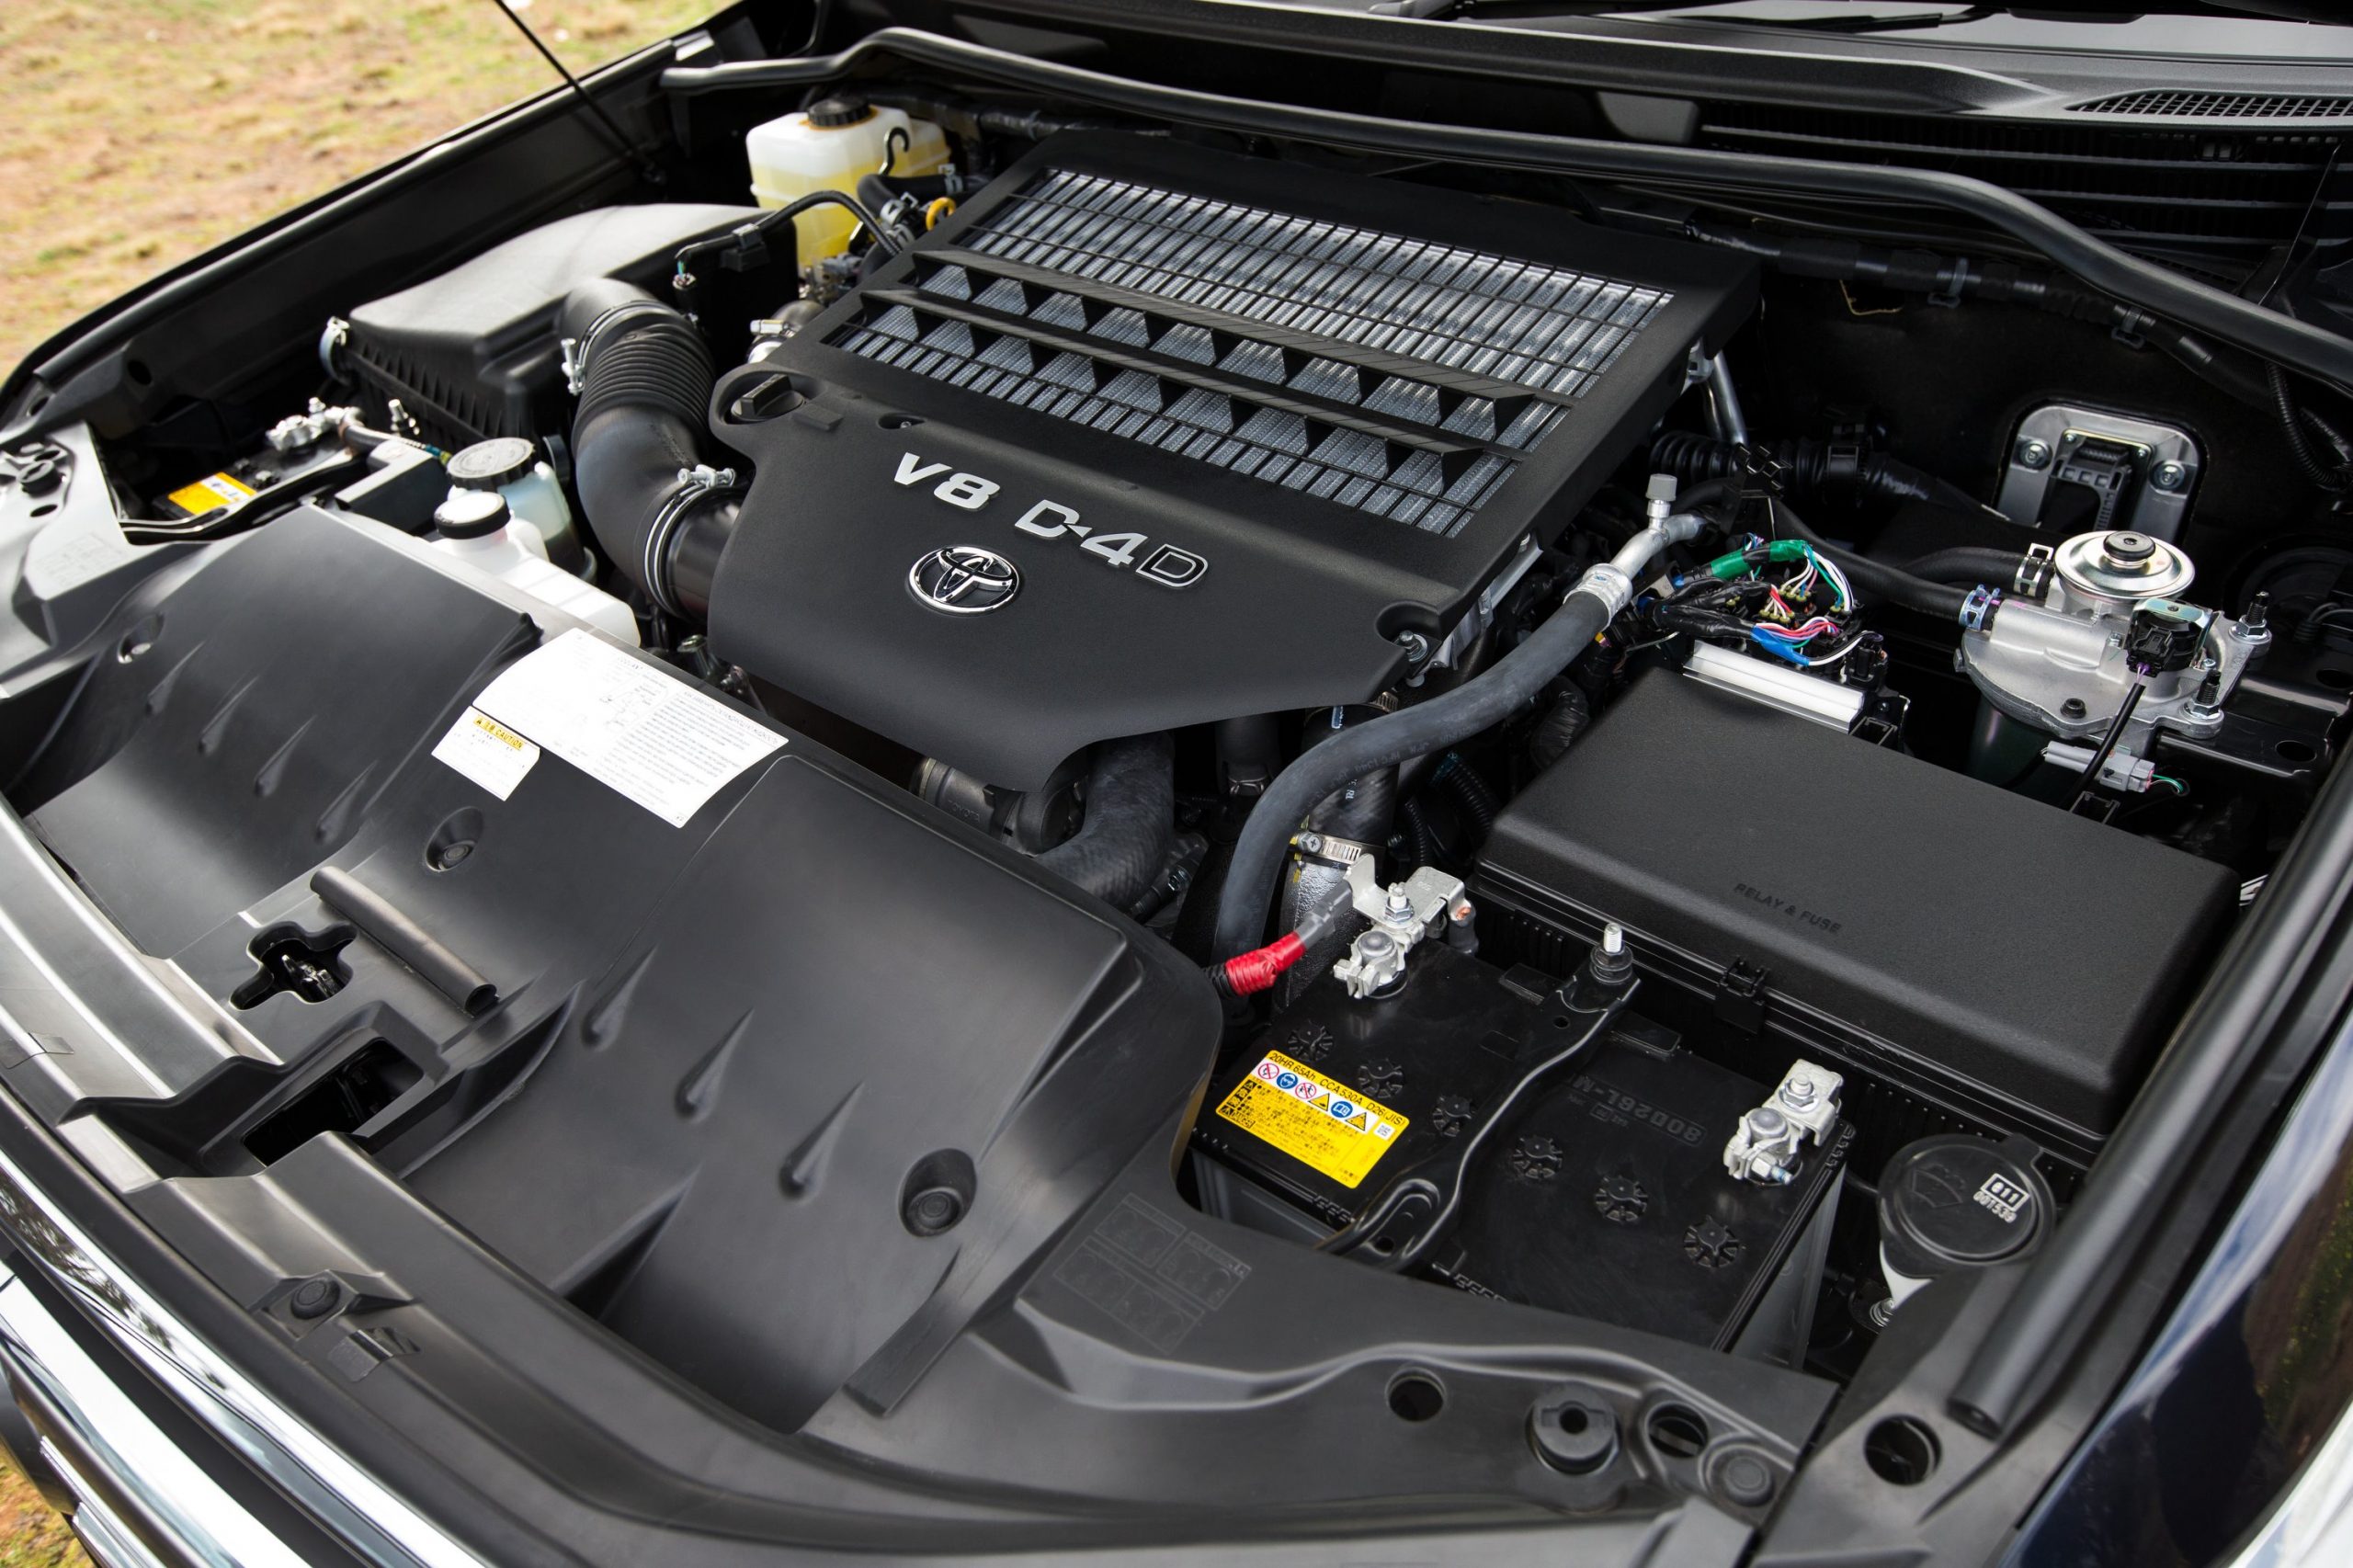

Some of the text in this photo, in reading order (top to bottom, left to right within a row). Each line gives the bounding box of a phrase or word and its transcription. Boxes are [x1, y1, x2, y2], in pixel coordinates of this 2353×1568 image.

[893, 451, 1210, 589] V8 D-4D
[496, 728, 523, 749] CAUTION
[1733, 882, 1843, 934] RELAY & FUSE
[1268, 1052, 1406, 1127] 20HR 65Ah CCA 530A D26(JIS)
[1972, 1190, 2018, 1224] 001539
